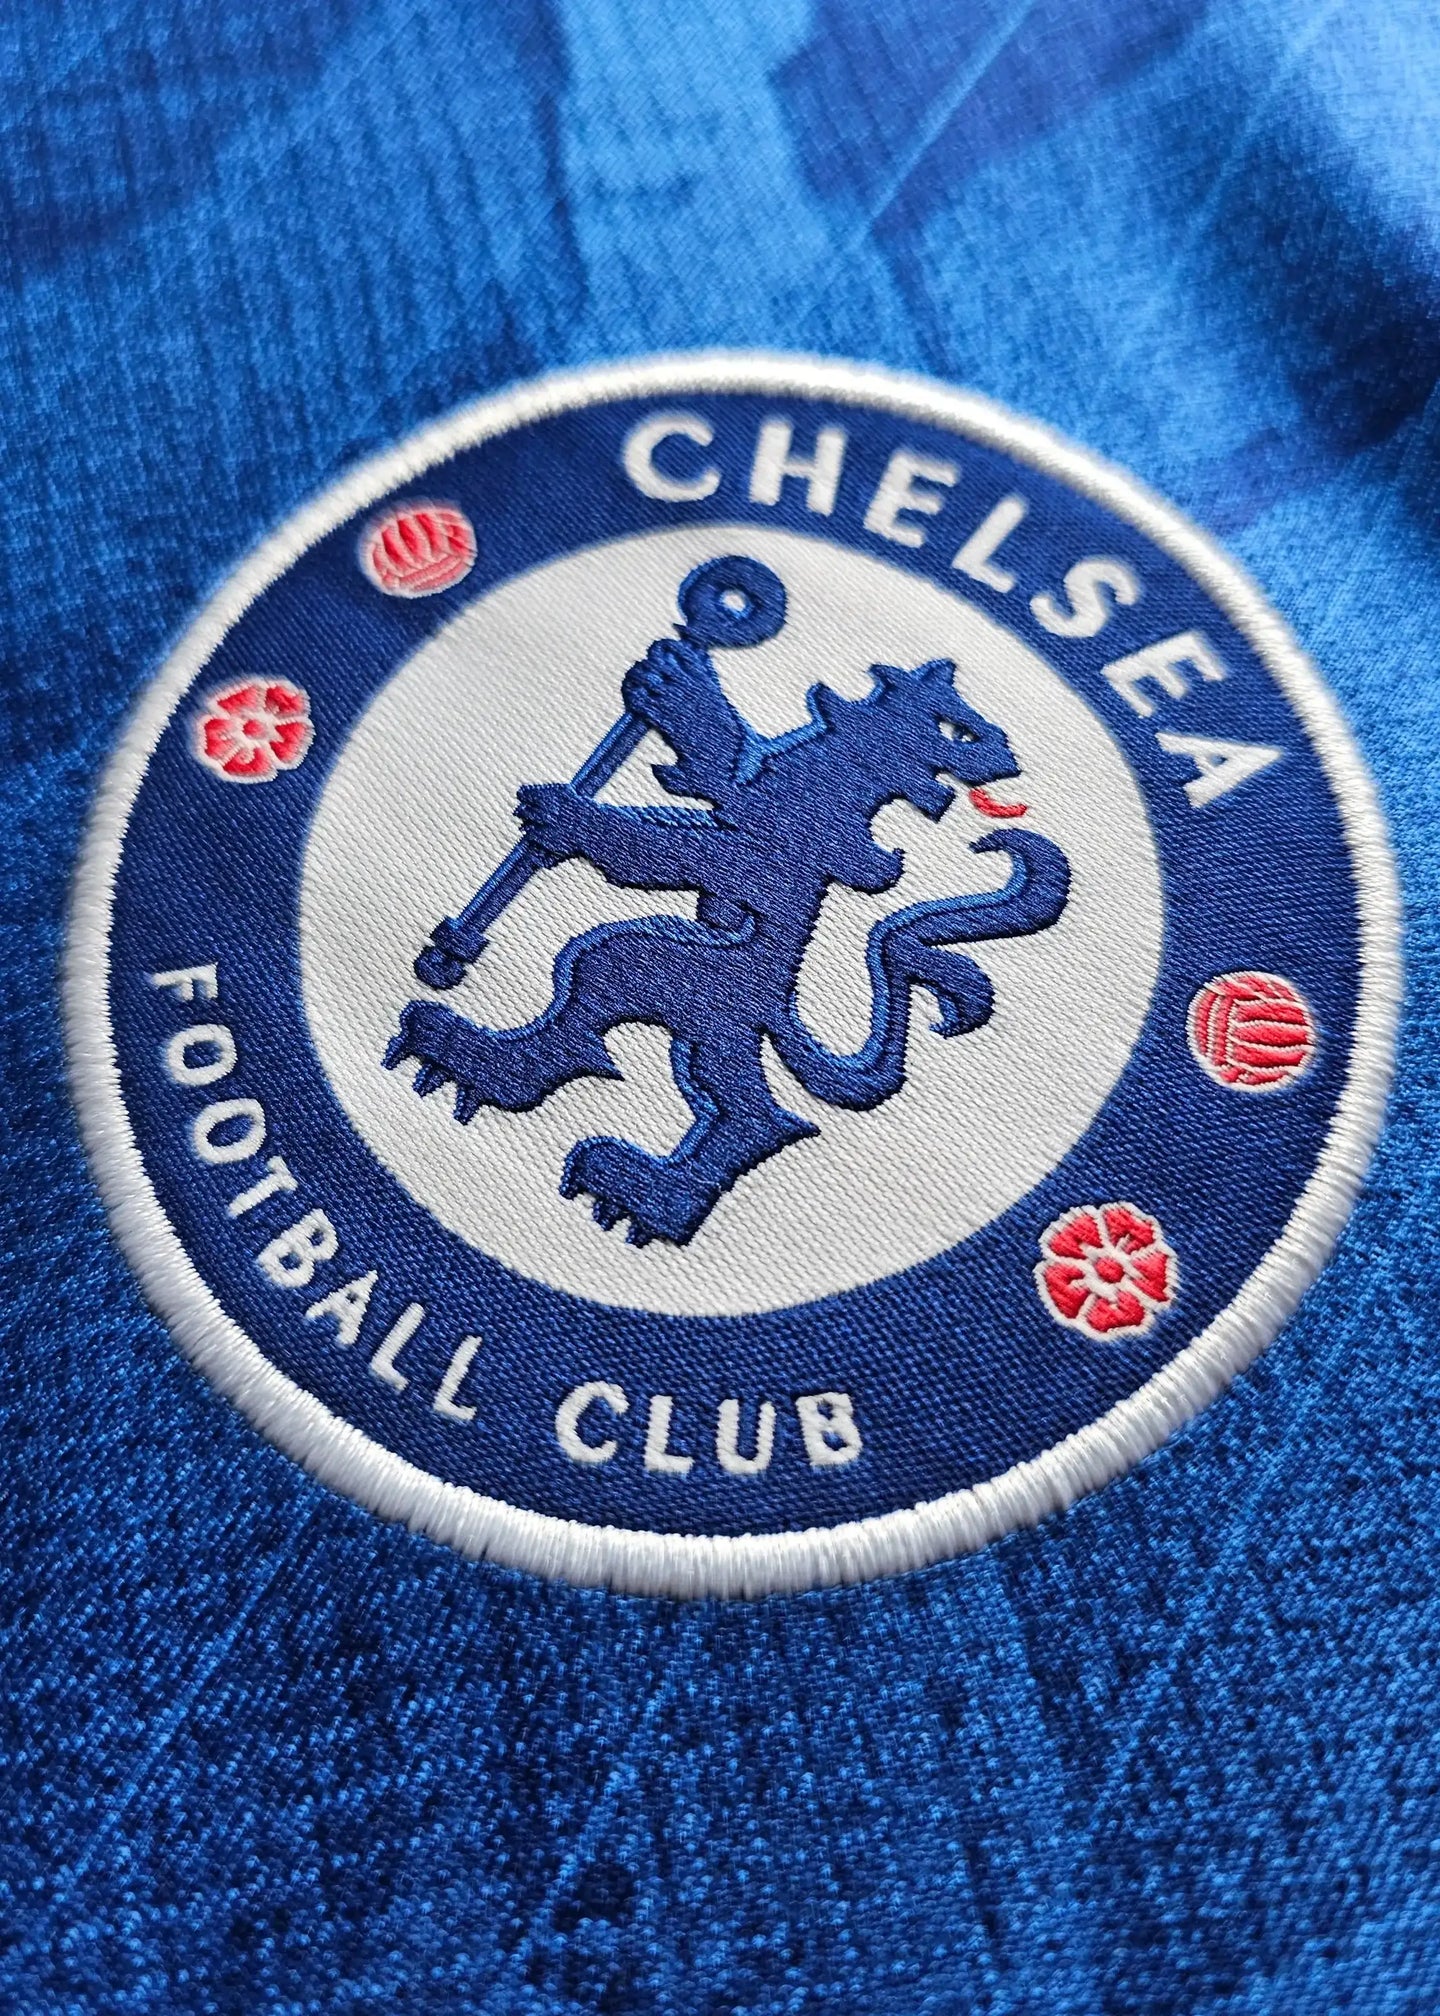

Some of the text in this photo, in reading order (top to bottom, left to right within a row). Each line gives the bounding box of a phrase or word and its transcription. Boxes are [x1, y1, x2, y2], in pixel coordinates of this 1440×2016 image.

[620, 413, 1289, 811] CHELSEA
[148, 961, 865, 1479] FOOTBALL CLUB
